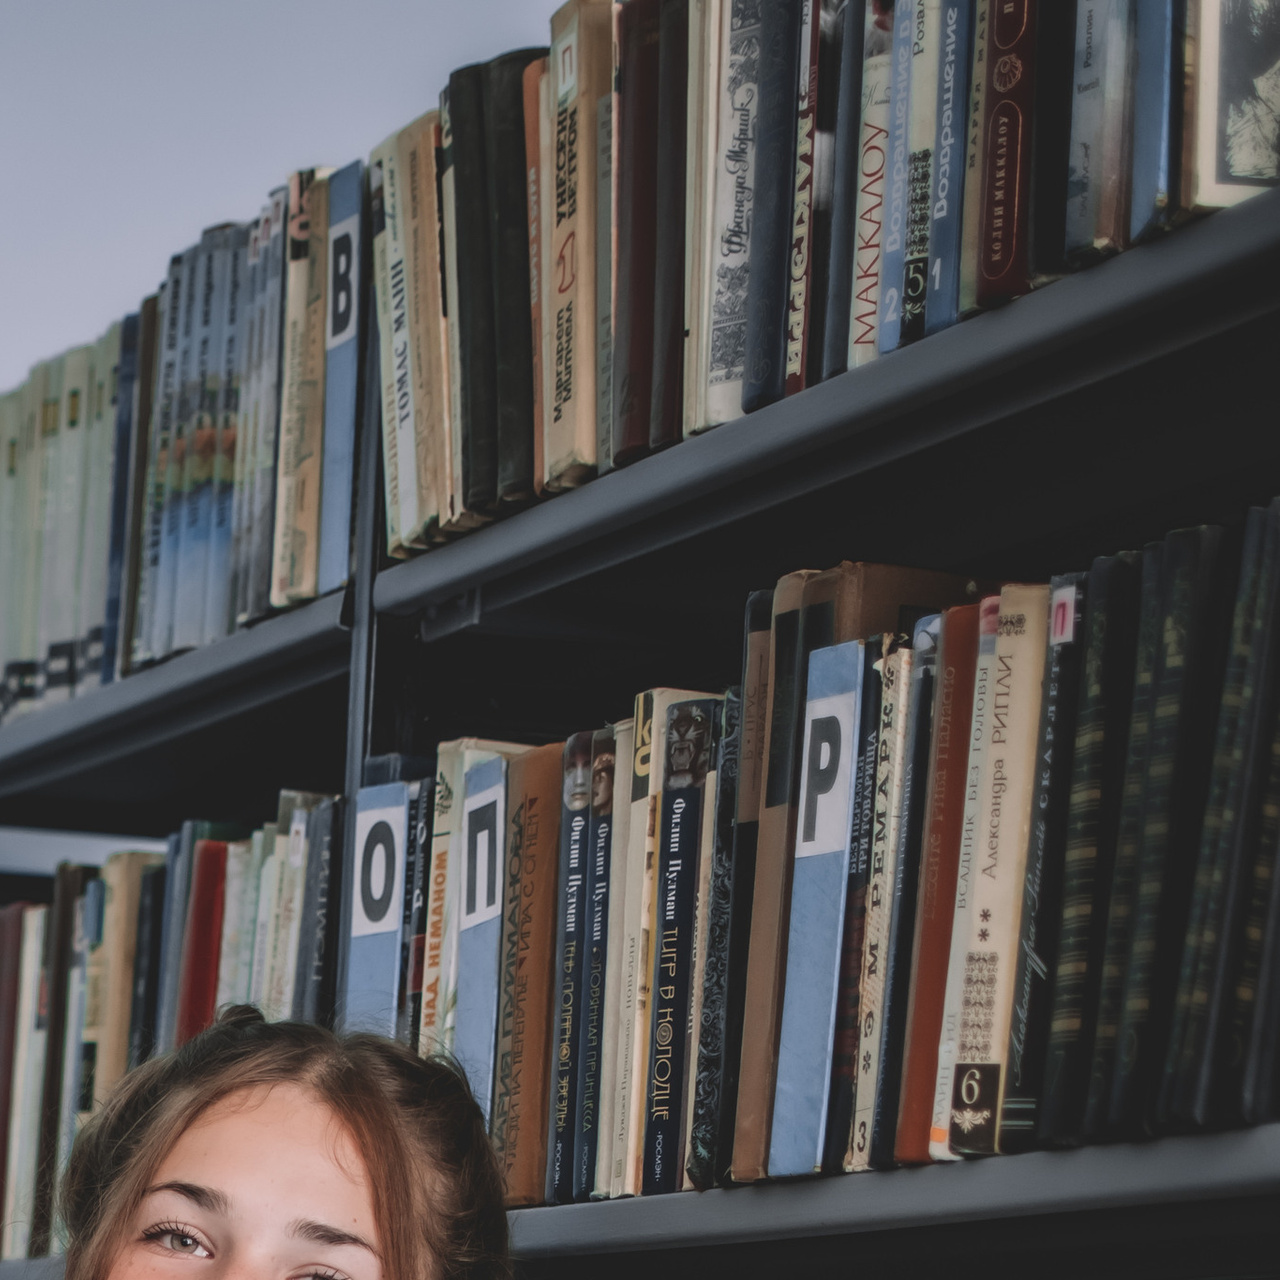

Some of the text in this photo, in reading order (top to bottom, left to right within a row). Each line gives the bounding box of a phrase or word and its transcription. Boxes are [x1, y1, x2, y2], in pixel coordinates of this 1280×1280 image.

[567, 106, 578, 219] ВЕТРОМ
[885, 46, 910, 253] Возвращение
[933, 8, 958, 220] Возвращение
[969, 83, 981, 169] МАРИЯ
[993, 115, 1009, 200] МАККАЛОУ
[722, 89, 756, 257] Франсуа Мориак
[332, 231, 353, 337] В
[853, 122, 888, 346] МАККАЛОУ
[907, 262, 924, 297] 5
[932, 258, 942, 291] 1
[390, 258, 406, 334] МАНН
[885, 288, 899, 323] 2
[393, 341, 410, 429] ТОМАС
[553, 308, 564, 424] Маргарет
[562, 301, 573, 403] Митчелл
[802, 715, 842, 842] Р
[848, 756, 865, 874] БЕЗ ПЕРЕМЕН
[858, 730, 878, 872] ТРИ ТОВАРИЩА
[871, 703, 894, 909] РЕМАРК
[956, 667, 988, 910] ВСАДНИК БЕЗ ГОЛОВЫ
[981, 655, 1013, 881] Александра РИПЛИ
[361, 820, 395, 923] О
[466, 799, 497, 916] П
[569, 815, 585, 869] Филип
[593, 821, 610, 876] Филип
[423, 849, 448, 1028] НАД НЕМАНОМ
[501, 803, 526, 1038] ПУЙМАНОВА
[565, 875, 582, 933] Пулман
[591, 881, 607, 941] Пулман
[563, 940, 576, 973] ТЕНЬ
[652, 798, 685, 1121] Филип Пулман ТИГР В КОЛОДЦЕ
[857, 1121, 867, 1153] 3
[933, 1066, 951, 1127] МАЙН
[961, 1069, 981, 1104] 6
